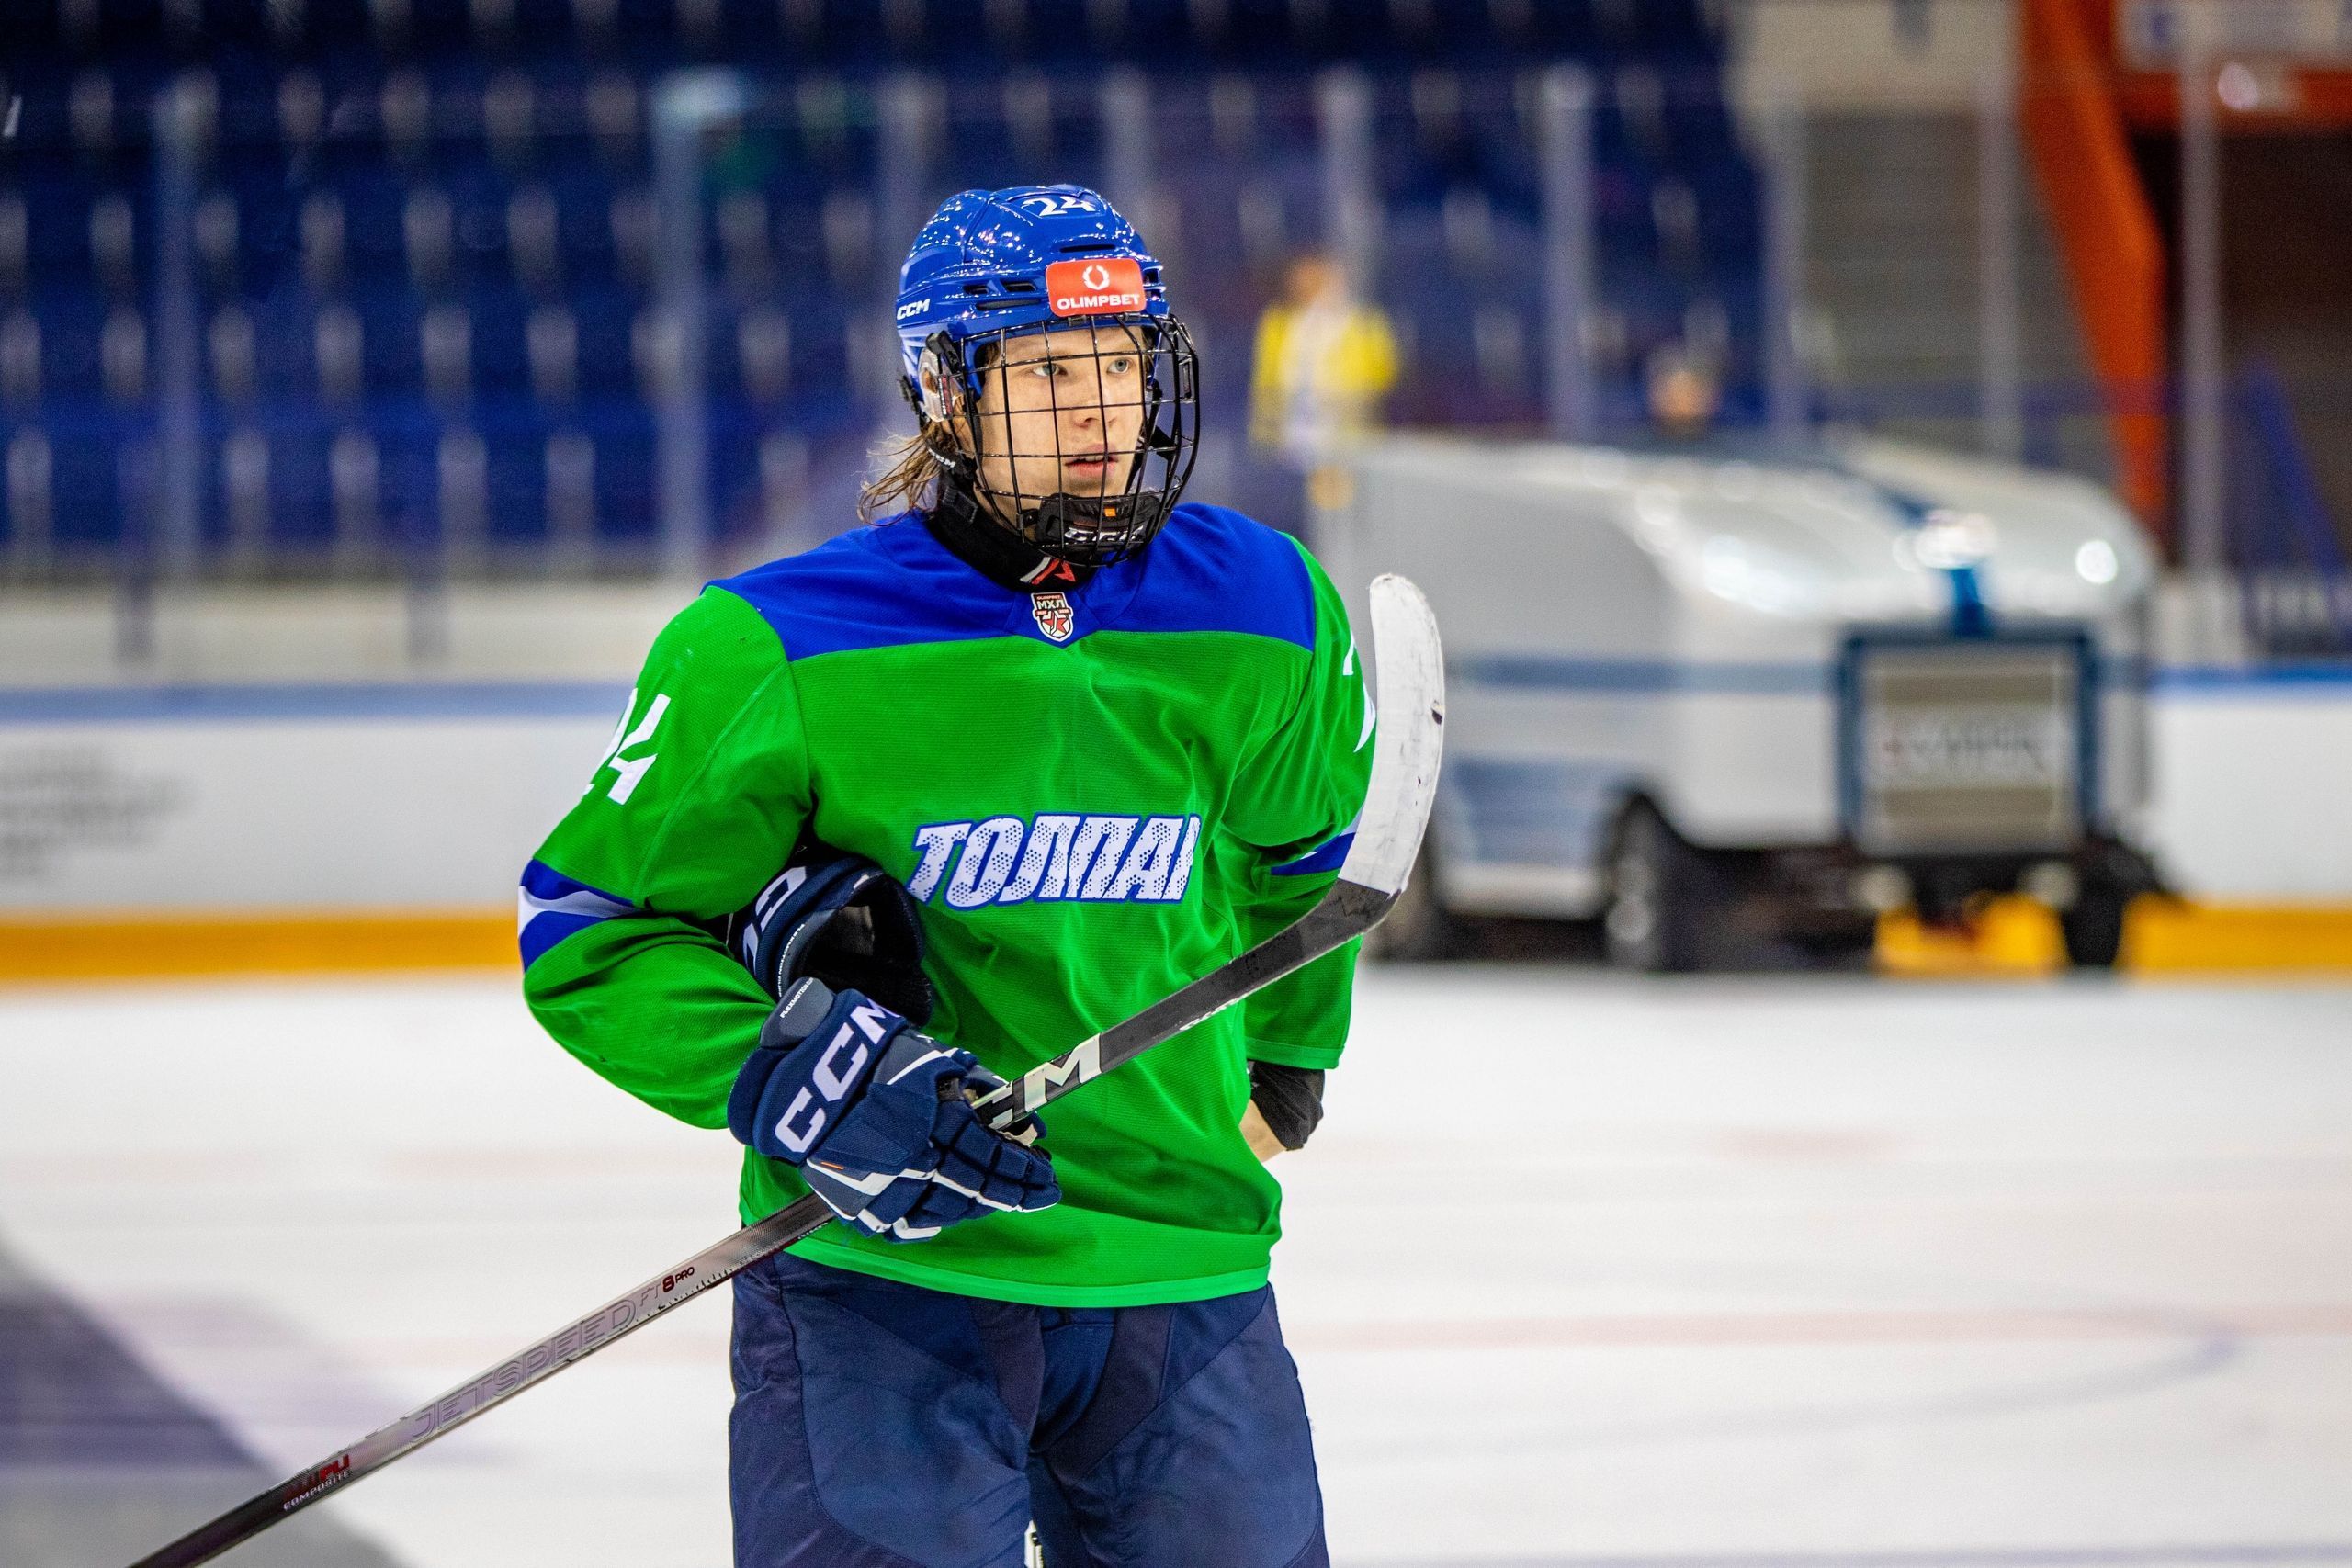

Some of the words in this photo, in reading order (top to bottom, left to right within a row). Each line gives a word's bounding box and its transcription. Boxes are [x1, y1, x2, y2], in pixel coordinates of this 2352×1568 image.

[1022, 195, 1097, 217] 24
[896, 298, 931, 321] CCM
[1057, 292, 1141, 310] OLIMPBET
[1036, 599, 1067, 610] МХЛ
[409, 1297, 638, 1439] JETSPEED
[674, 1266, 695, 1284] PRO
